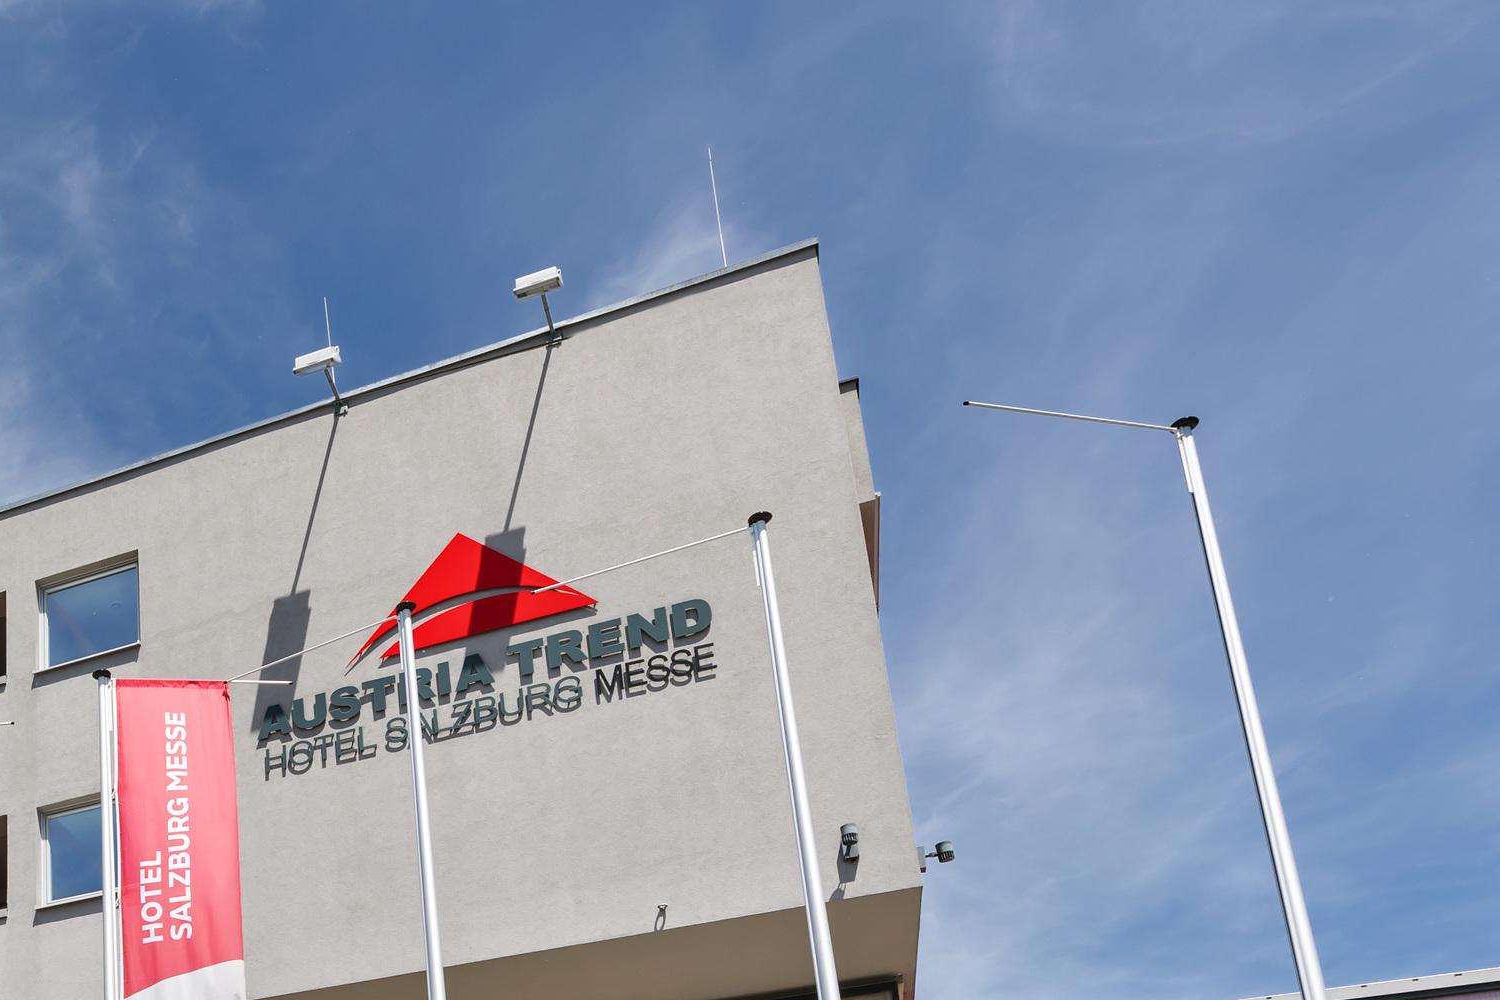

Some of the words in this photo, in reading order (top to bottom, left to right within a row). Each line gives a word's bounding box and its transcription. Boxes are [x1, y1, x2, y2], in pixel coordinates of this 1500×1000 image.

[257, 654, 495, 741] AUSTRIA
[506, 599, 712, 676] TREND
[265, 726, 376, 778] HOTEL
[595, 643, 716, 696] MESSE
[164, 712, 188, 790] MESSE
[140, 851, 163, 944] HOTEL
[167, 797, 192, 940] SALZBURG
